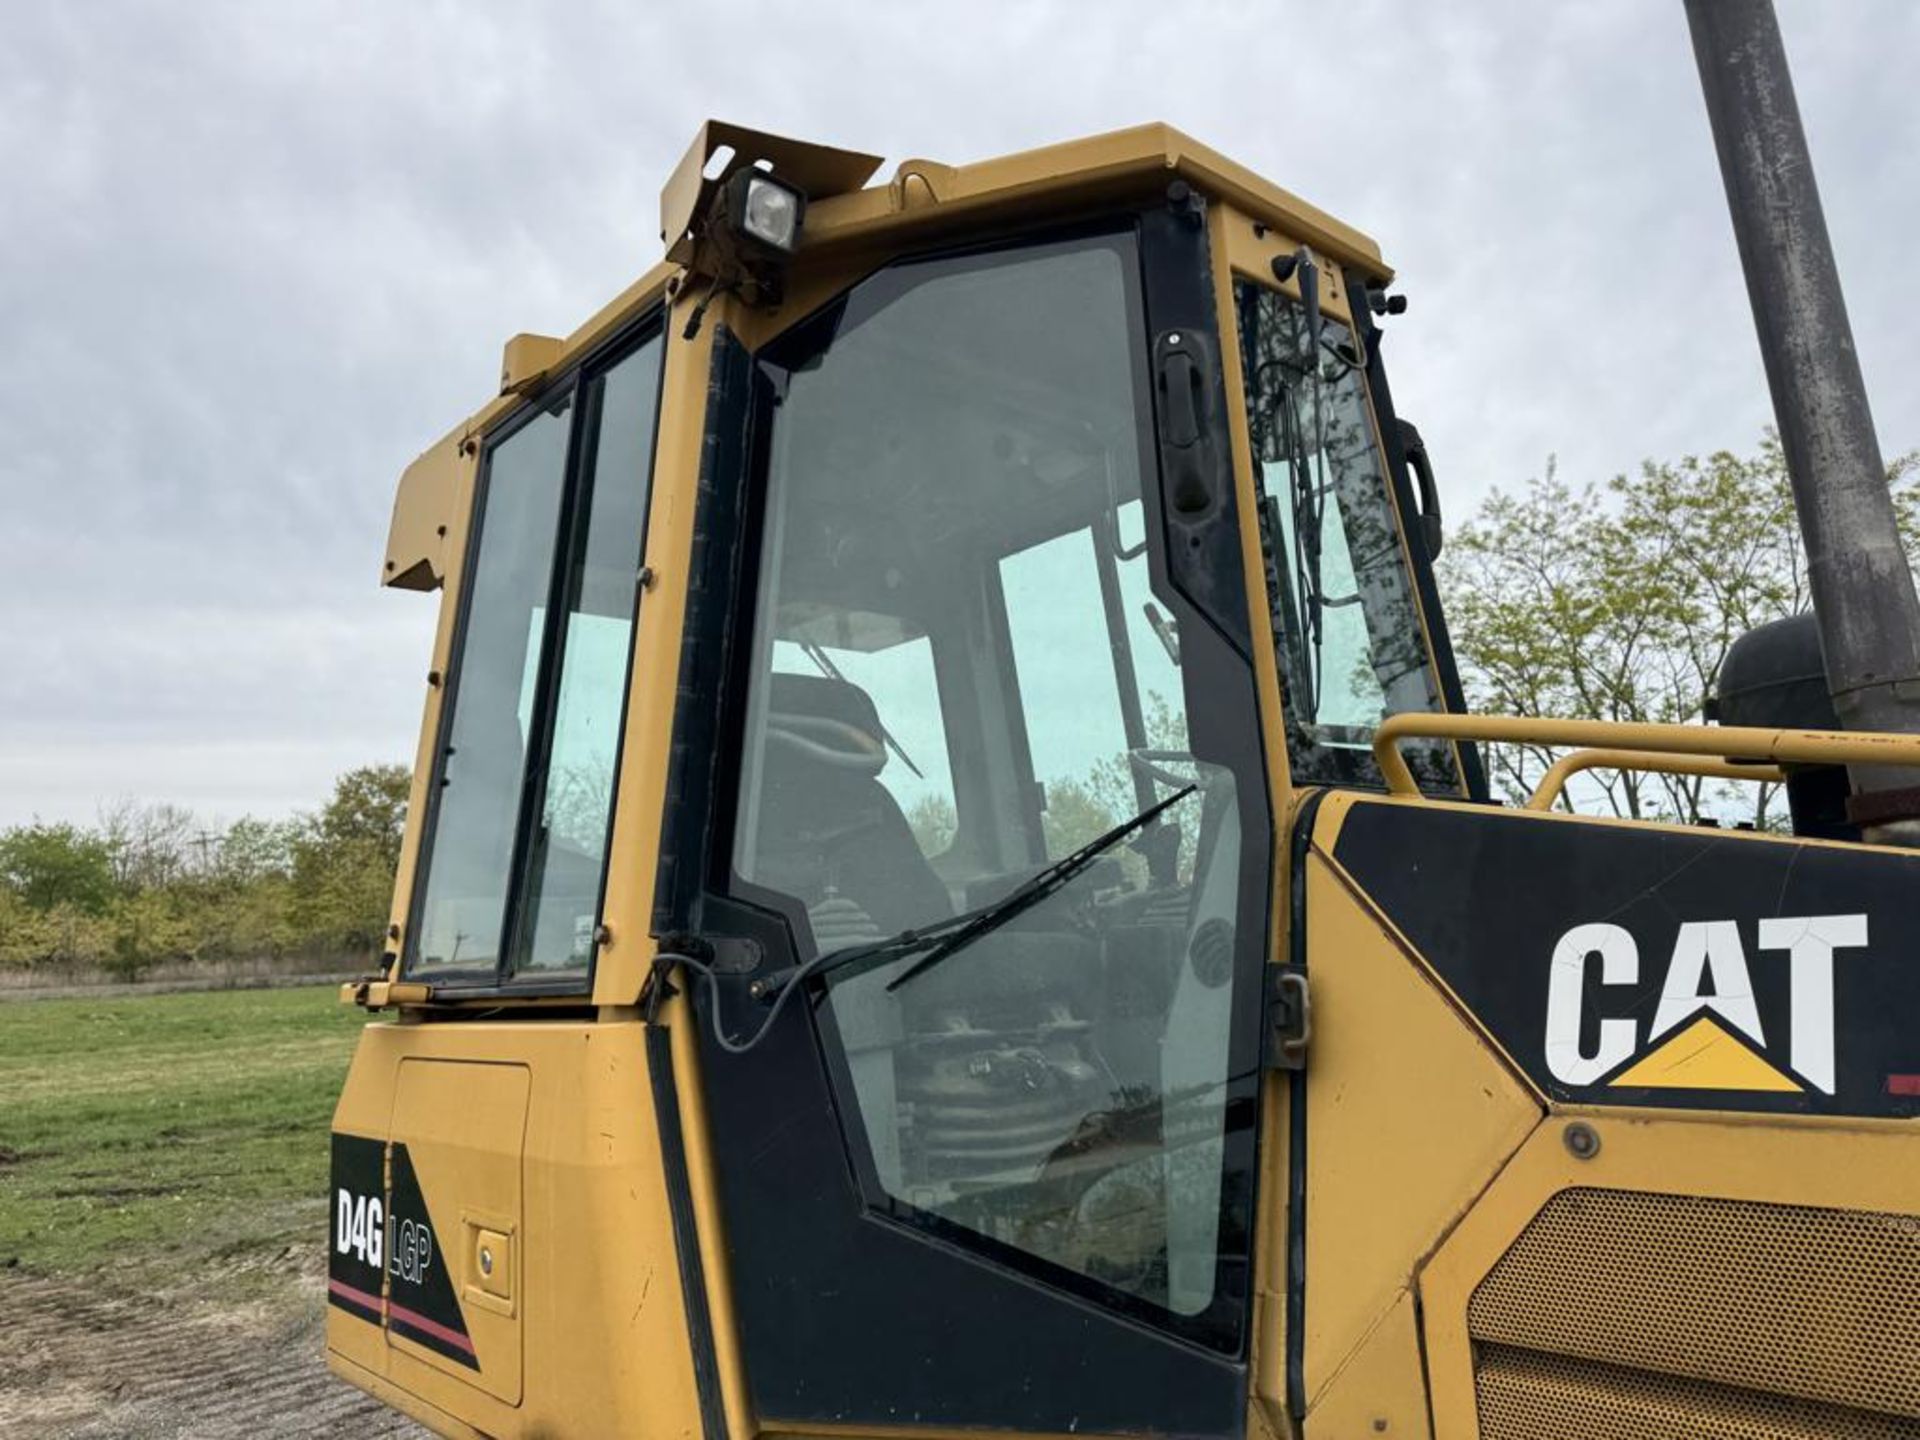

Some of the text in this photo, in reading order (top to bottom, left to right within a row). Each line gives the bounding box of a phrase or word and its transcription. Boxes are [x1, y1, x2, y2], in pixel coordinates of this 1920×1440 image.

[1544, 913, 1869, 1096] CAT
[337, 1187, 432, 1284] D4G LGP
